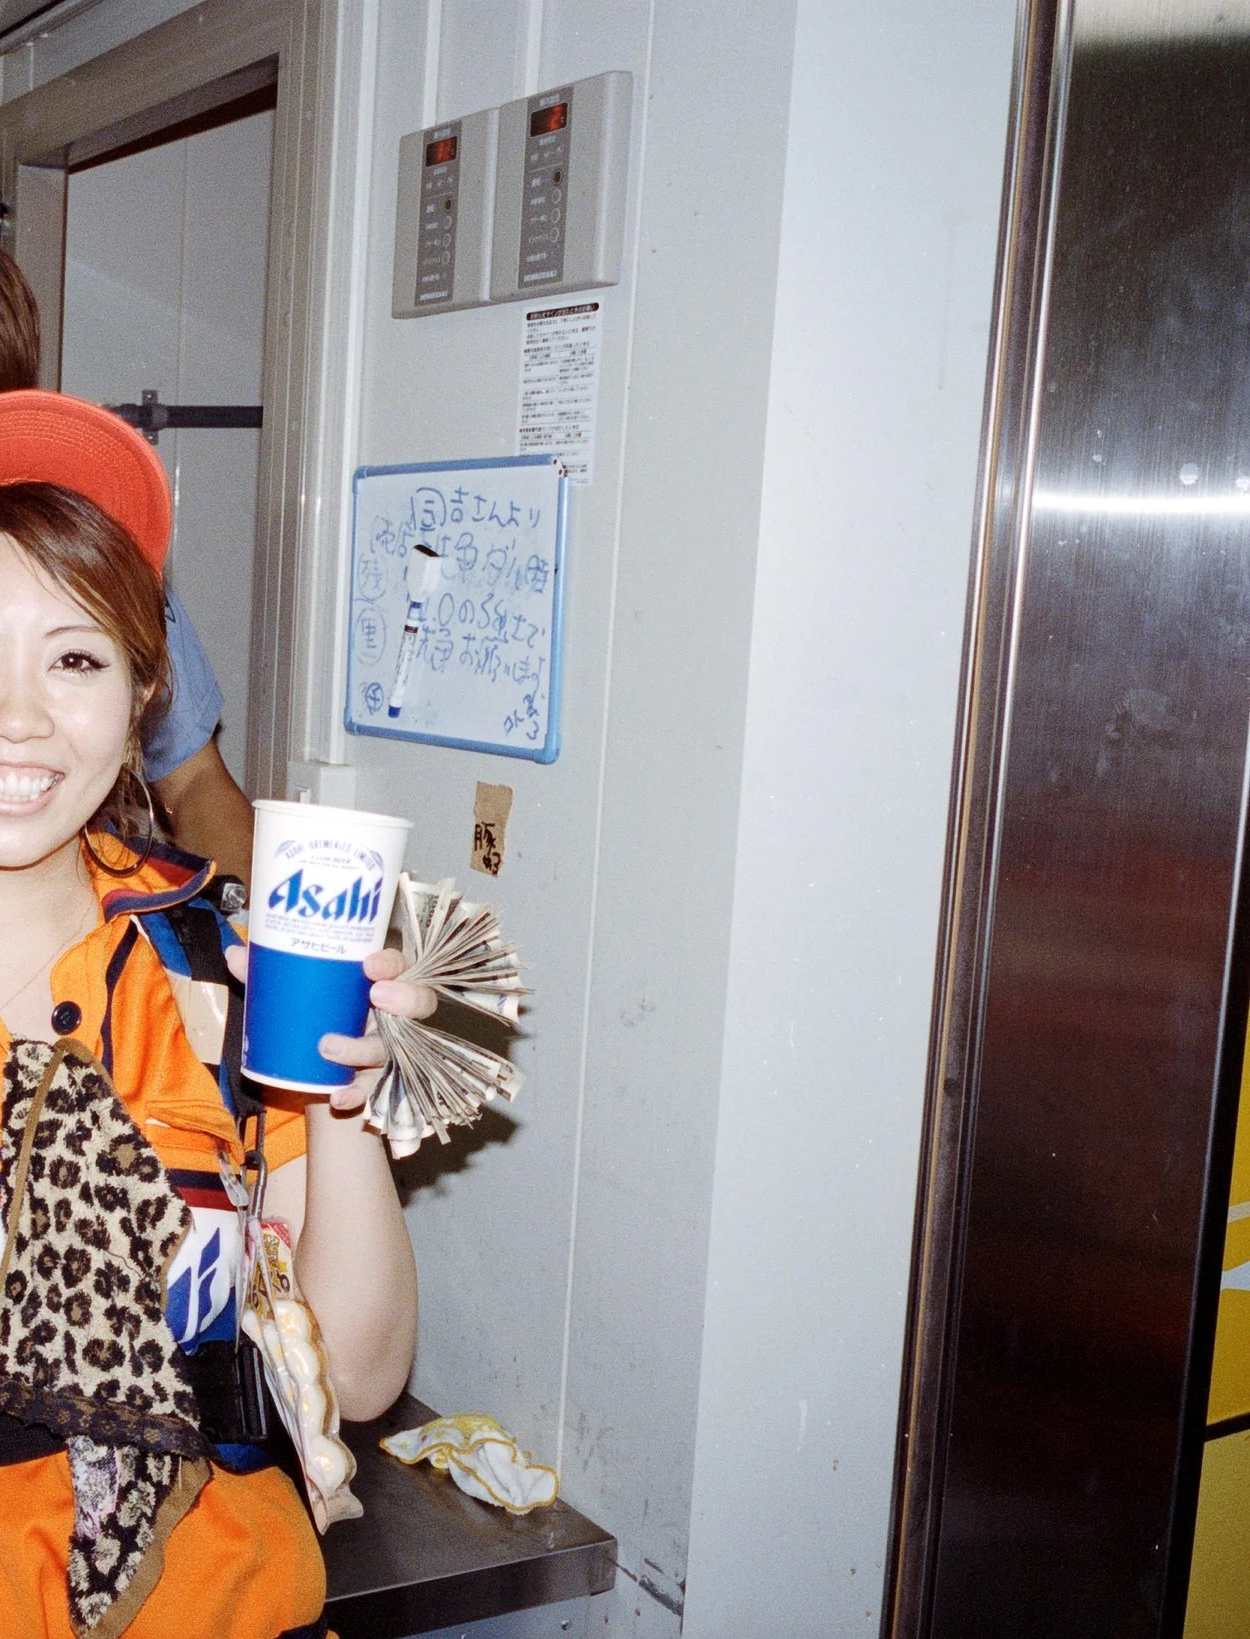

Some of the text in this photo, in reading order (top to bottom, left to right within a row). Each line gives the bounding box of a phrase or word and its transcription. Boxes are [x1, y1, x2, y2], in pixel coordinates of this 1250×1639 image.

[268, 867, 384, 924] Asahi
[290, 937, 347, 954] アサヒビール
